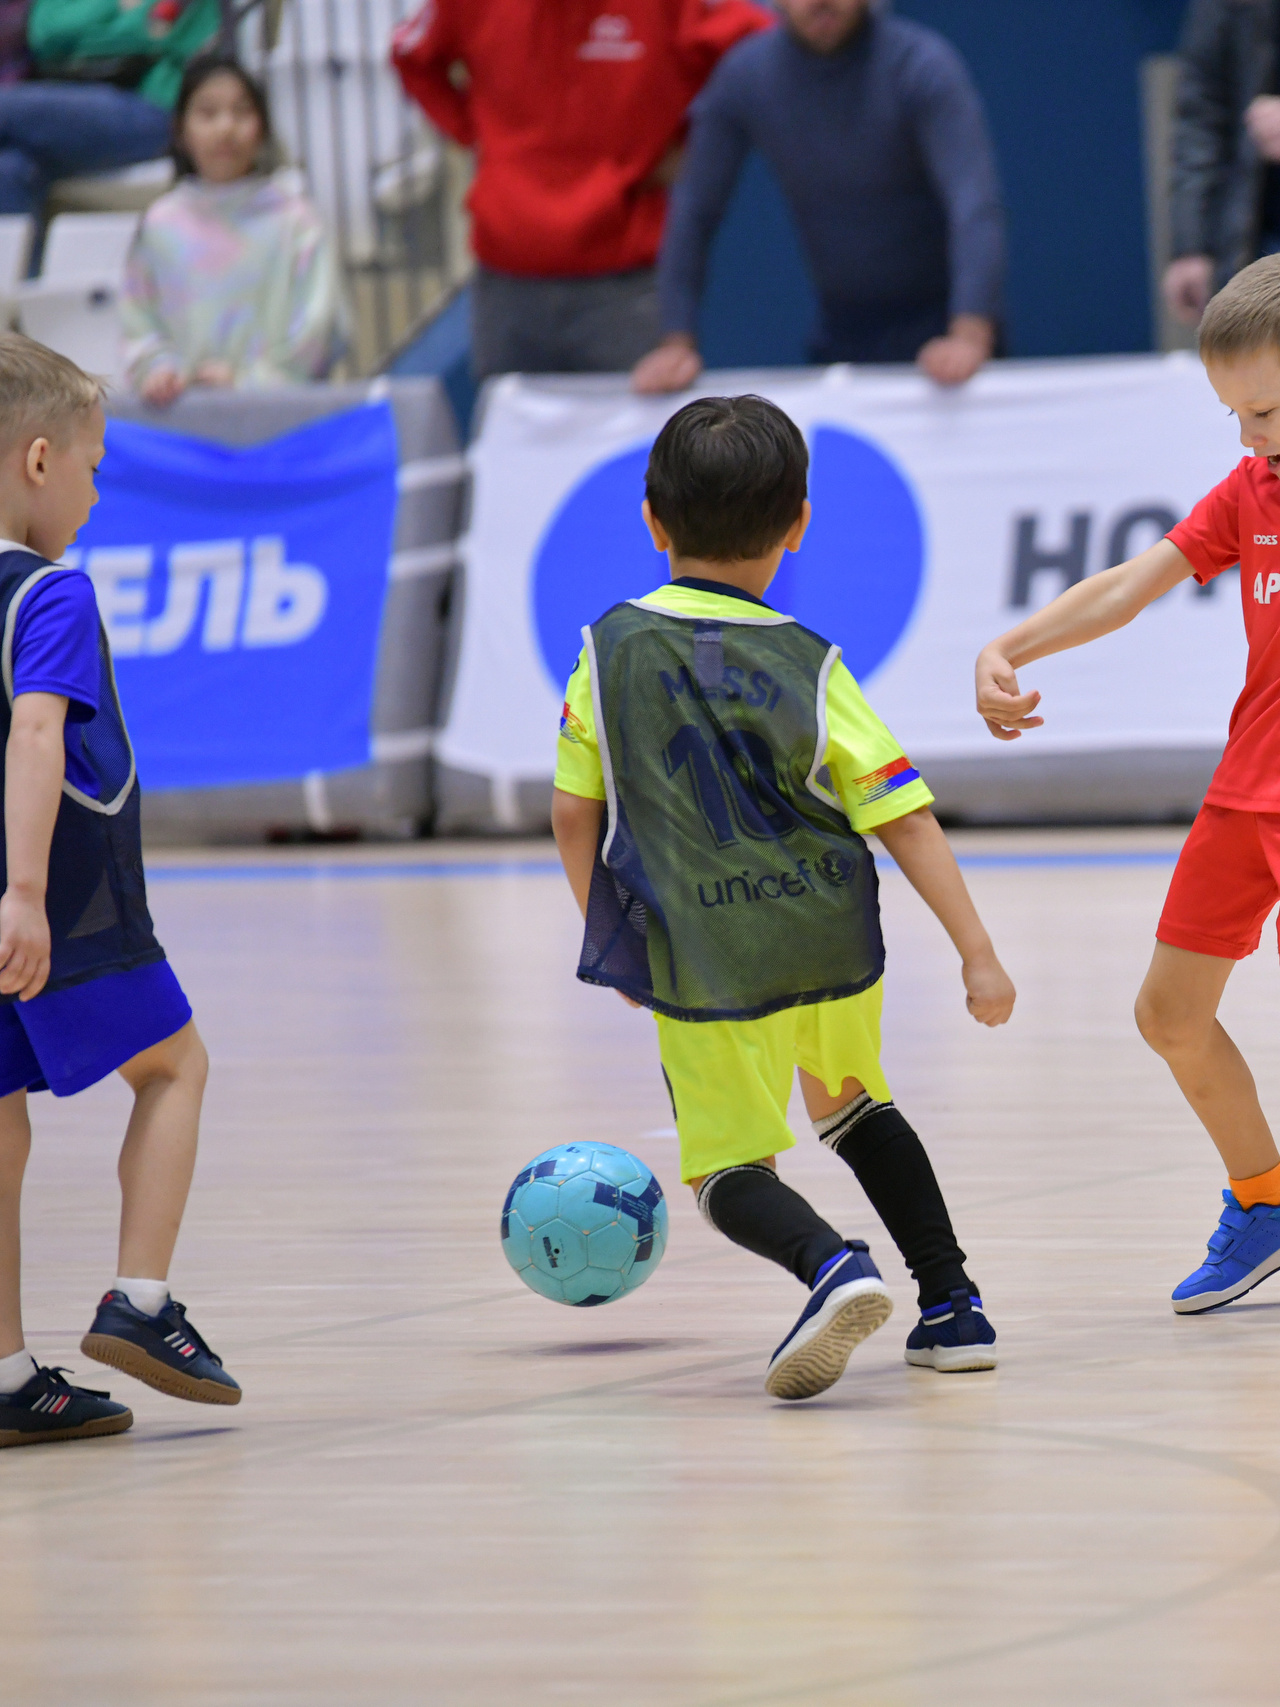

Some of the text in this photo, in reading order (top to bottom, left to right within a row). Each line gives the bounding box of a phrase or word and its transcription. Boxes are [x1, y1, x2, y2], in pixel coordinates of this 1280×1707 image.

[62, 534, 331, 659] ЕЛЬ
[662, 724, 801, 850] 10
[698, 858, 817, 908] unicef
